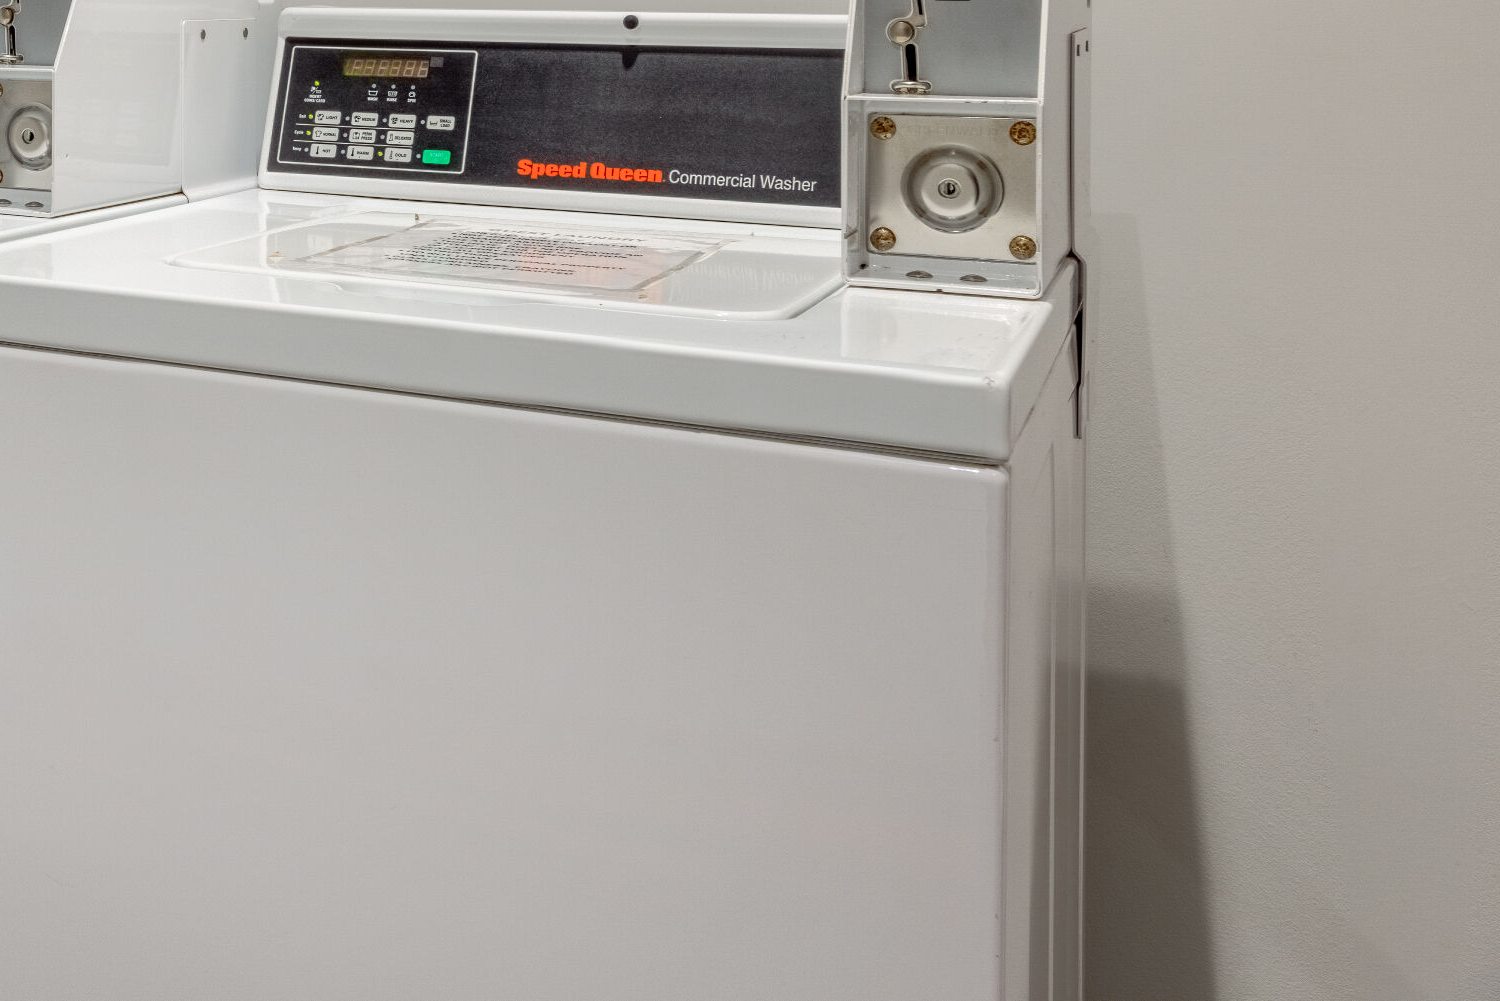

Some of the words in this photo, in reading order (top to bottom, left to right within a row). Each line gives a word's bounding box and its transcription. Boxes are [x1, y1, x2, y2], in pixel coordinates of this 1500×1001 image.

[517, 159, 587, 180] Speed
[590, 162, 663, 183] Queen
[668, 169, 756, 188] Commercial
[760, 174, 818, 192] Washer
